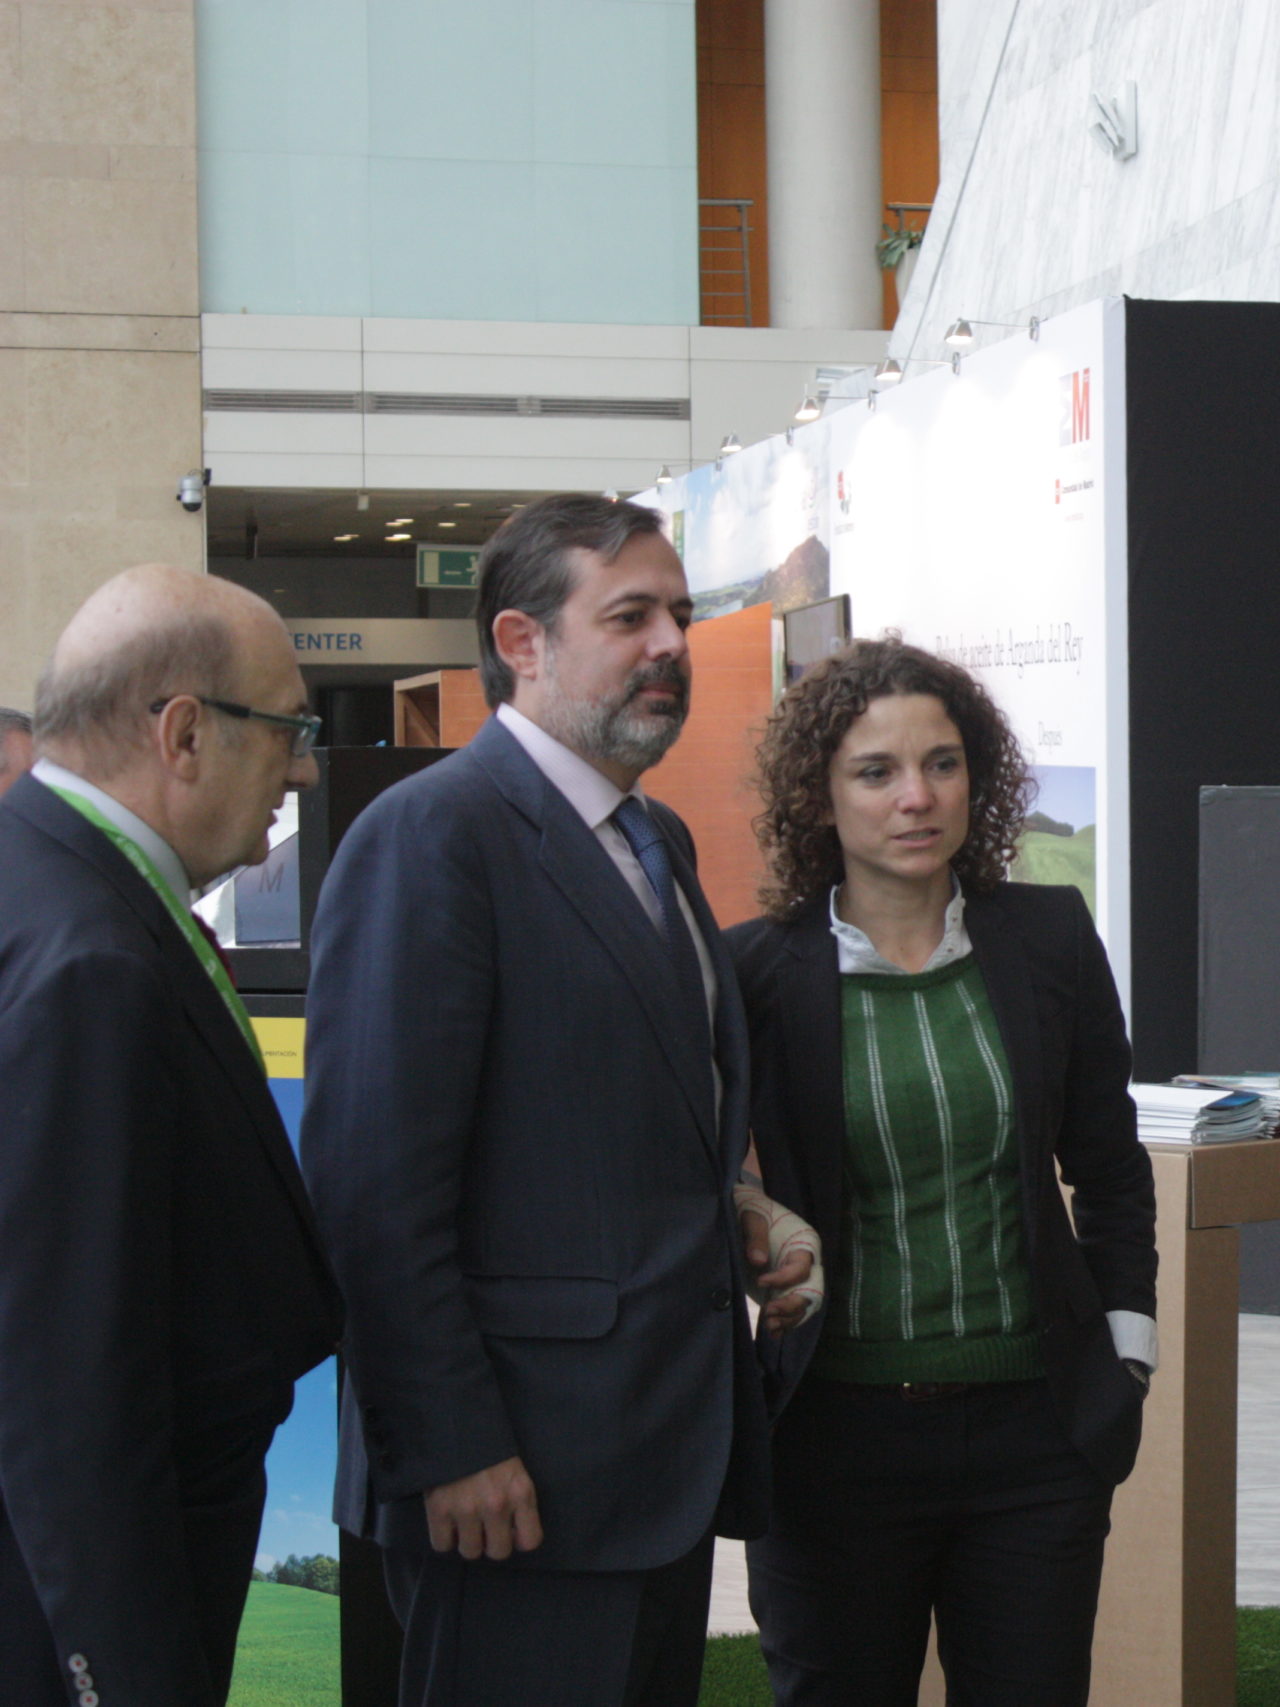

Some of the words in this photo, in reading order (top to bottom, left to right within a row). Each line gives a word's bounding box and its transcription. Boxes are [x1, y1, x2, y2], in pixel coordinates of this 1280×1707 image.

[289, 632, 363, 651] ENTER
[994, 628, 1004, 667] de
[1006, 627, 1045, 679] Arganda
[1048, 623, 1061, 664] del
[1064, 622, 1083, 677] Rey
